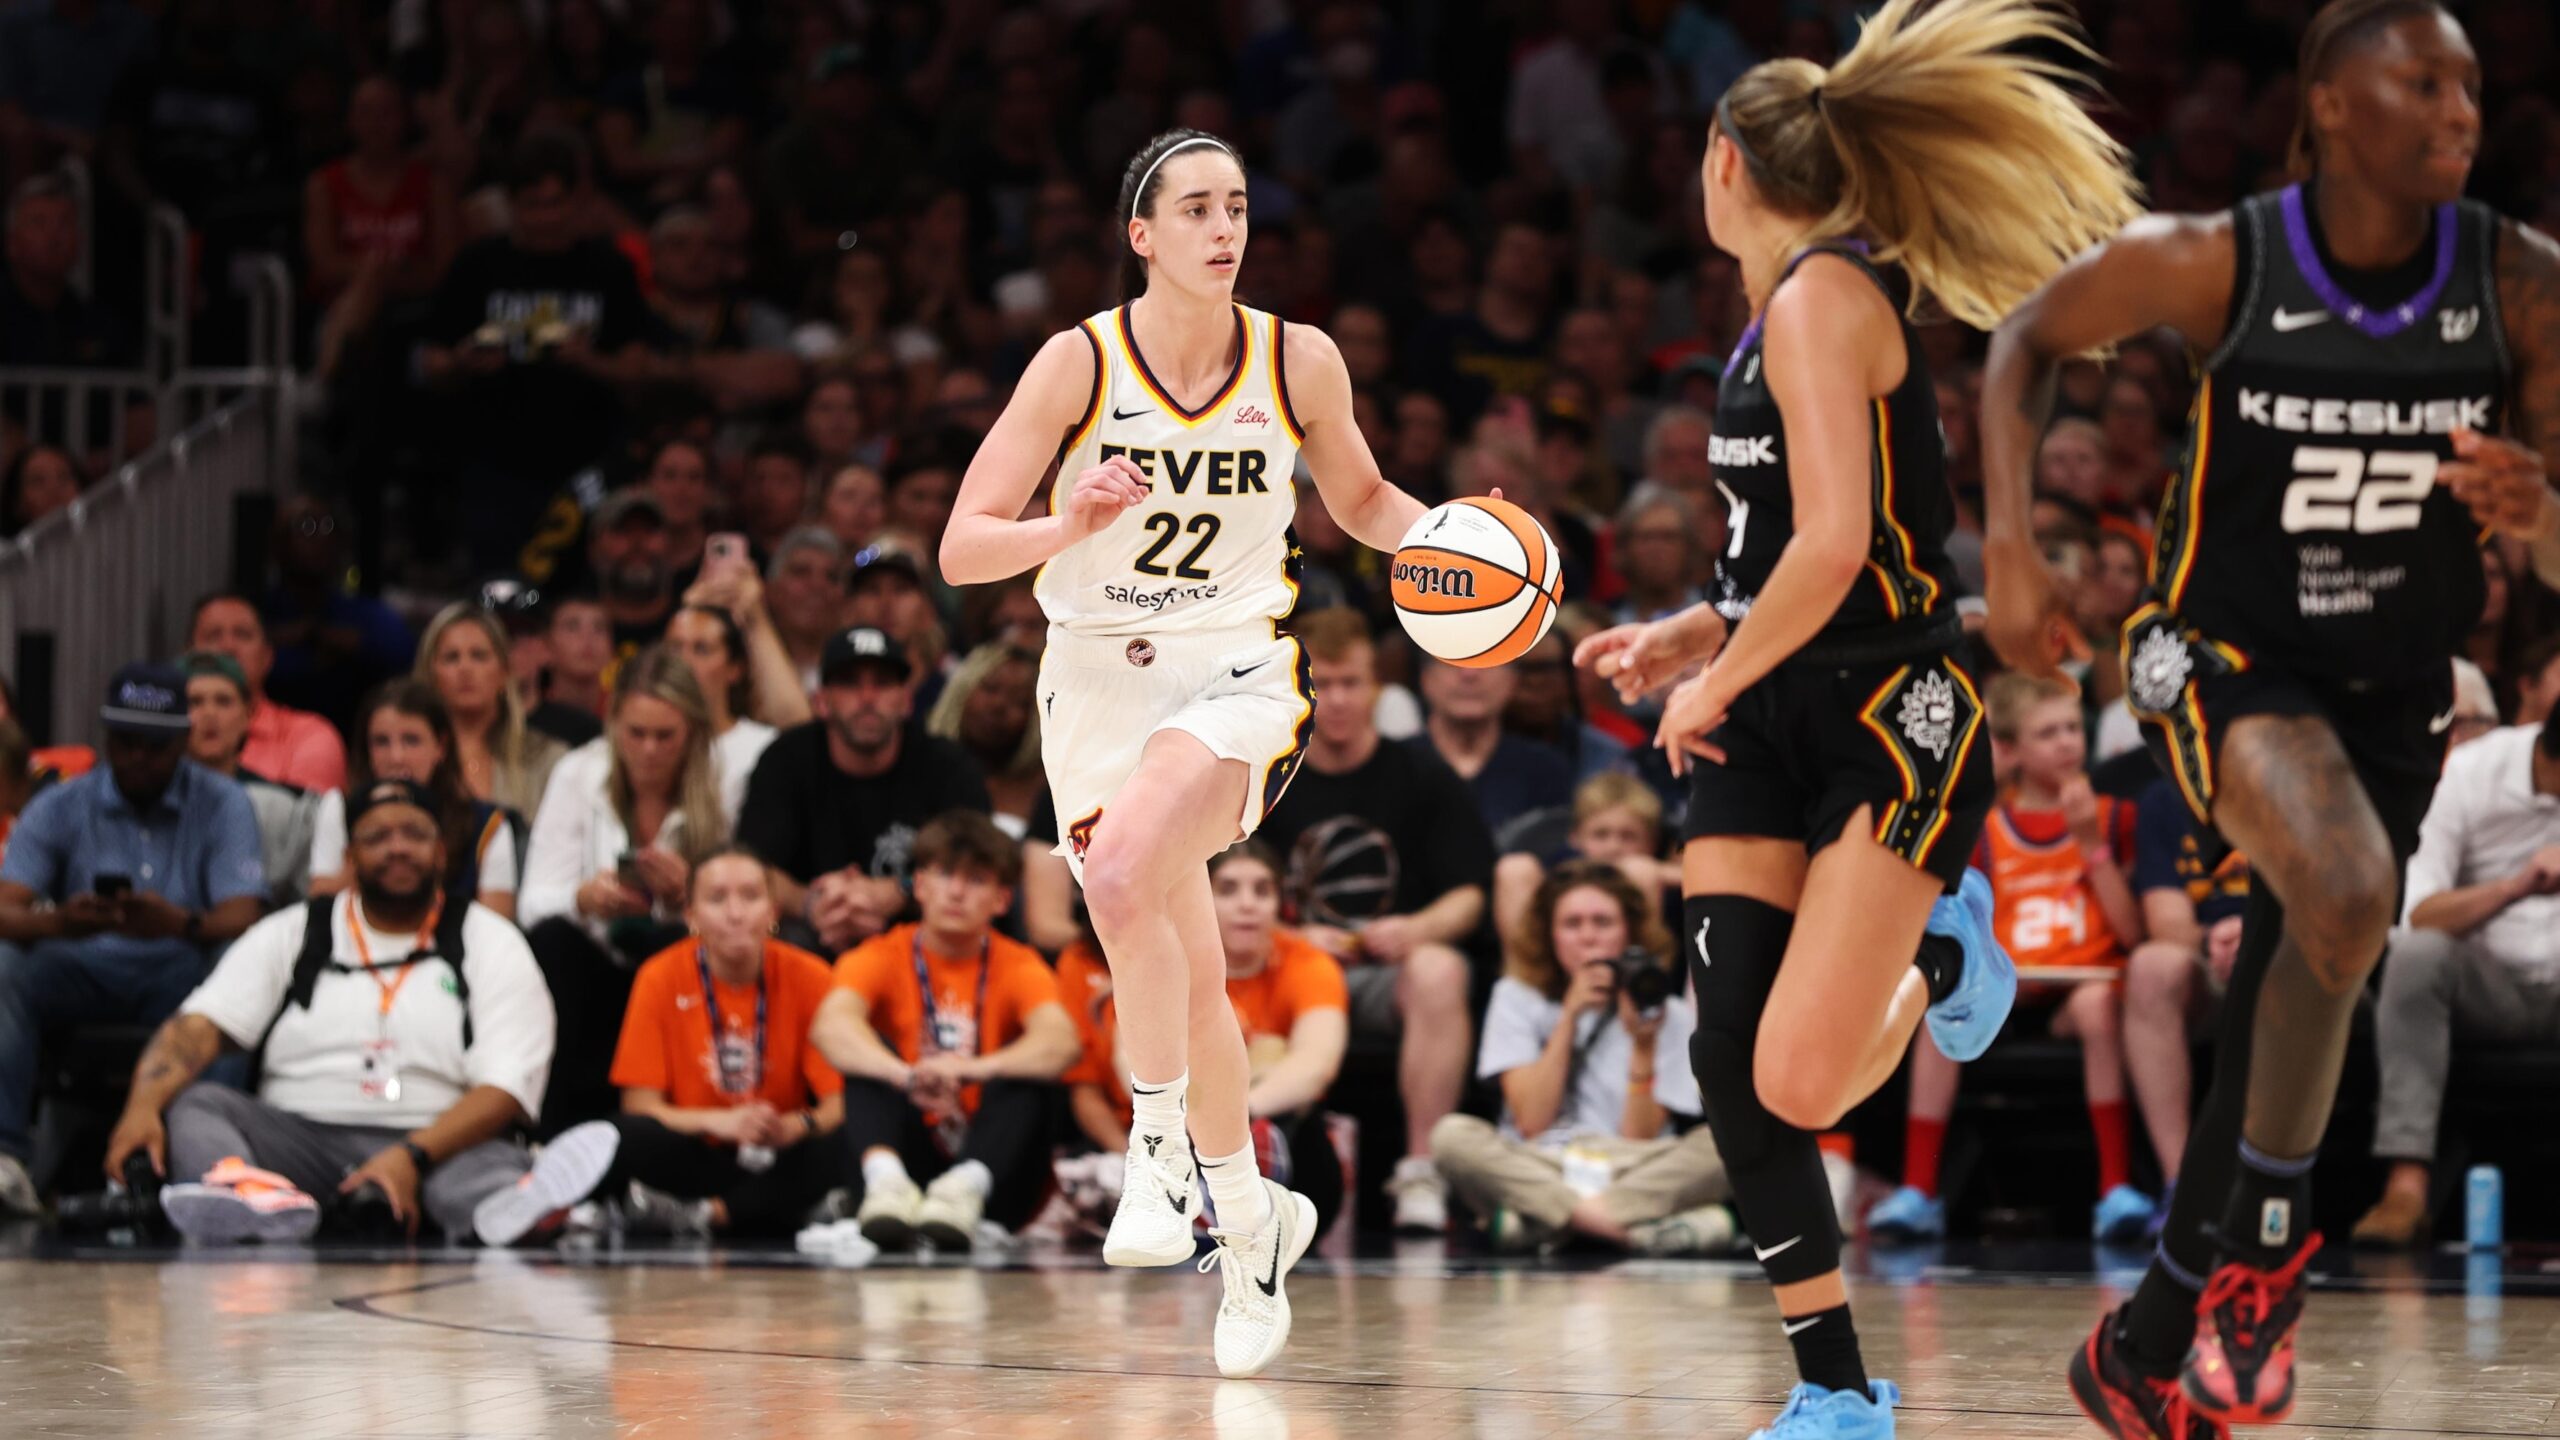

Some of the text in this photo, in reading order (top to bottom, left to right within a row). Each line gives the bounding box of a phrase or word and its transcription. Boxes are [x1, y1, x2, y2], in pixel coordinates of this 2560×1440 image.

[1234, 405, 1271, 429] Lilly
[2239, 387, 2492, 435] KEESUSK
[2281, 445, 2439, 534] 22
[1134, 512, 1221, 580] 22
[1392, 561, 1476, 598] Wilson
[2299, 590, 2374, 617] Health
[2012, 895, 2087, 950] 24
